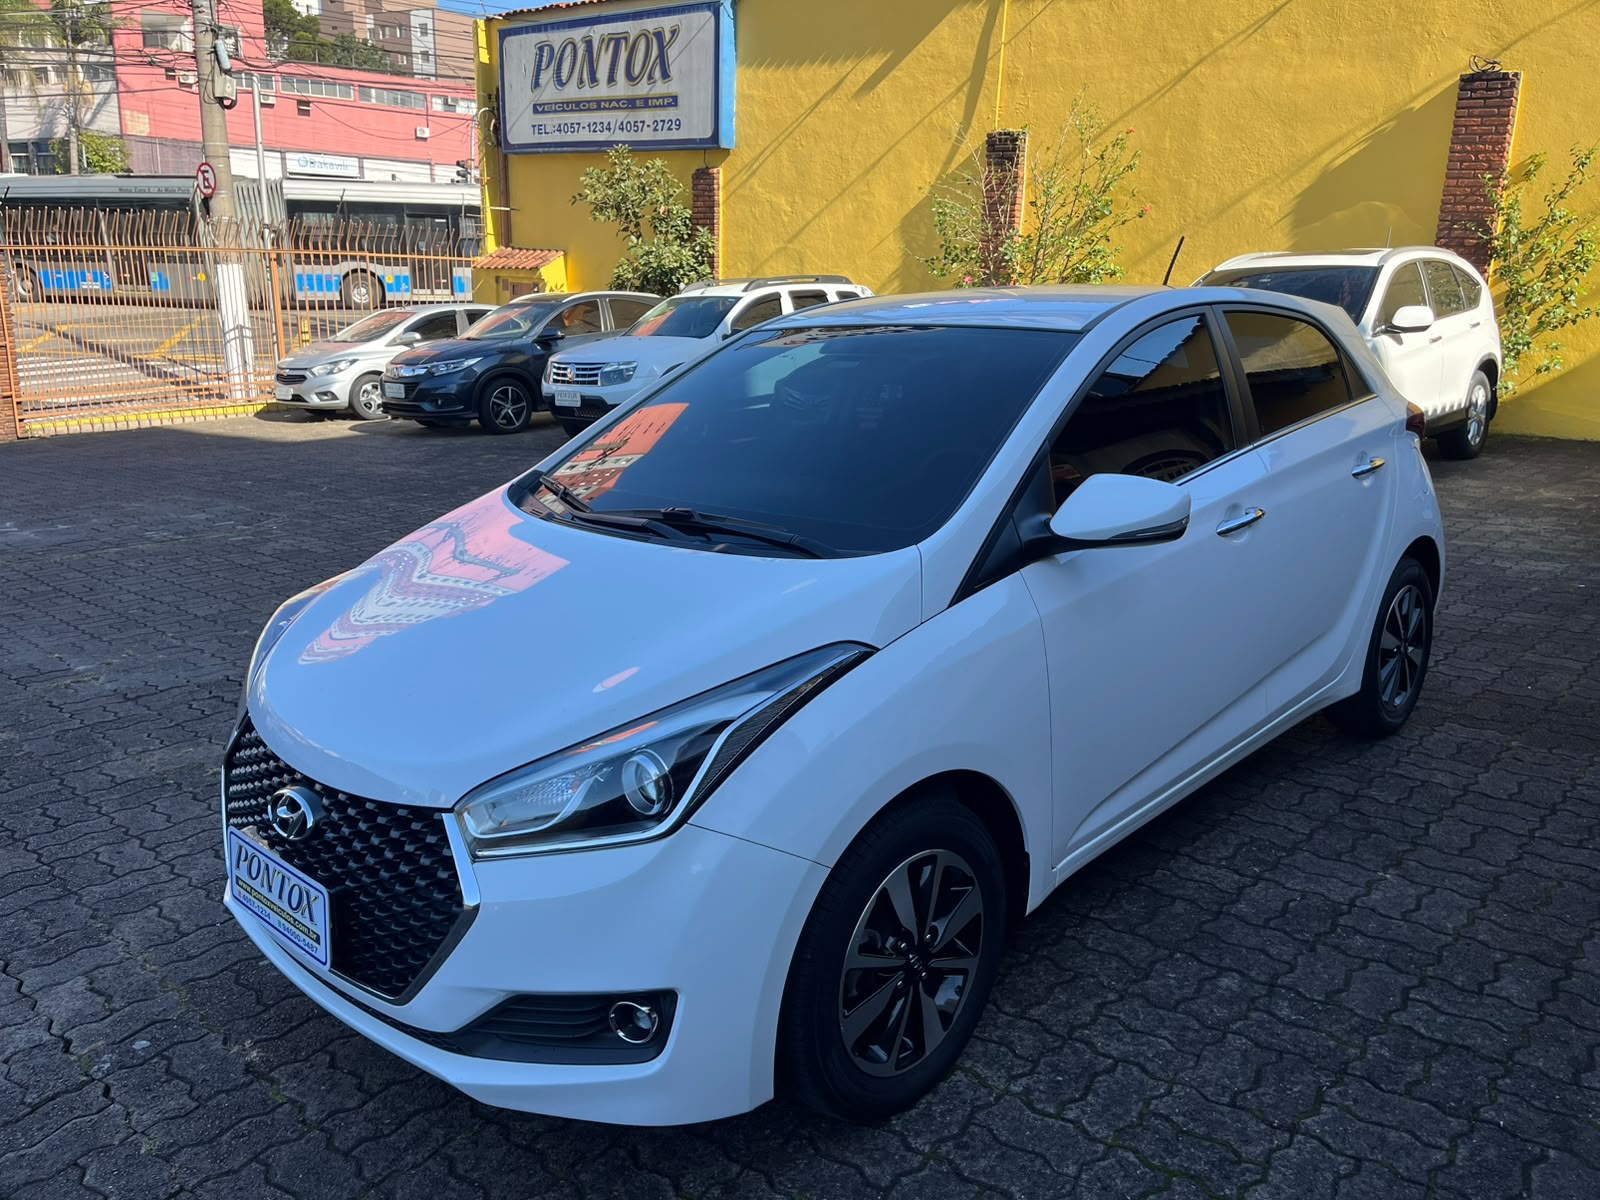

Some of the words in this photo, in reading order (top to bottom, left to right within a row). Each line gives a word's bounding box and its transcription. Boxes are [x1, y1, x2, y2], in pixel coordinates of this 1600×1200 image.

[531, 24, 680, 93] PONTOX
[600, 100, 632, 109] NAC.
[636, 99, 645, 107] E
[648, 97, 676, 107] IMP.
[235, 844, 319, 926] PONTOX
